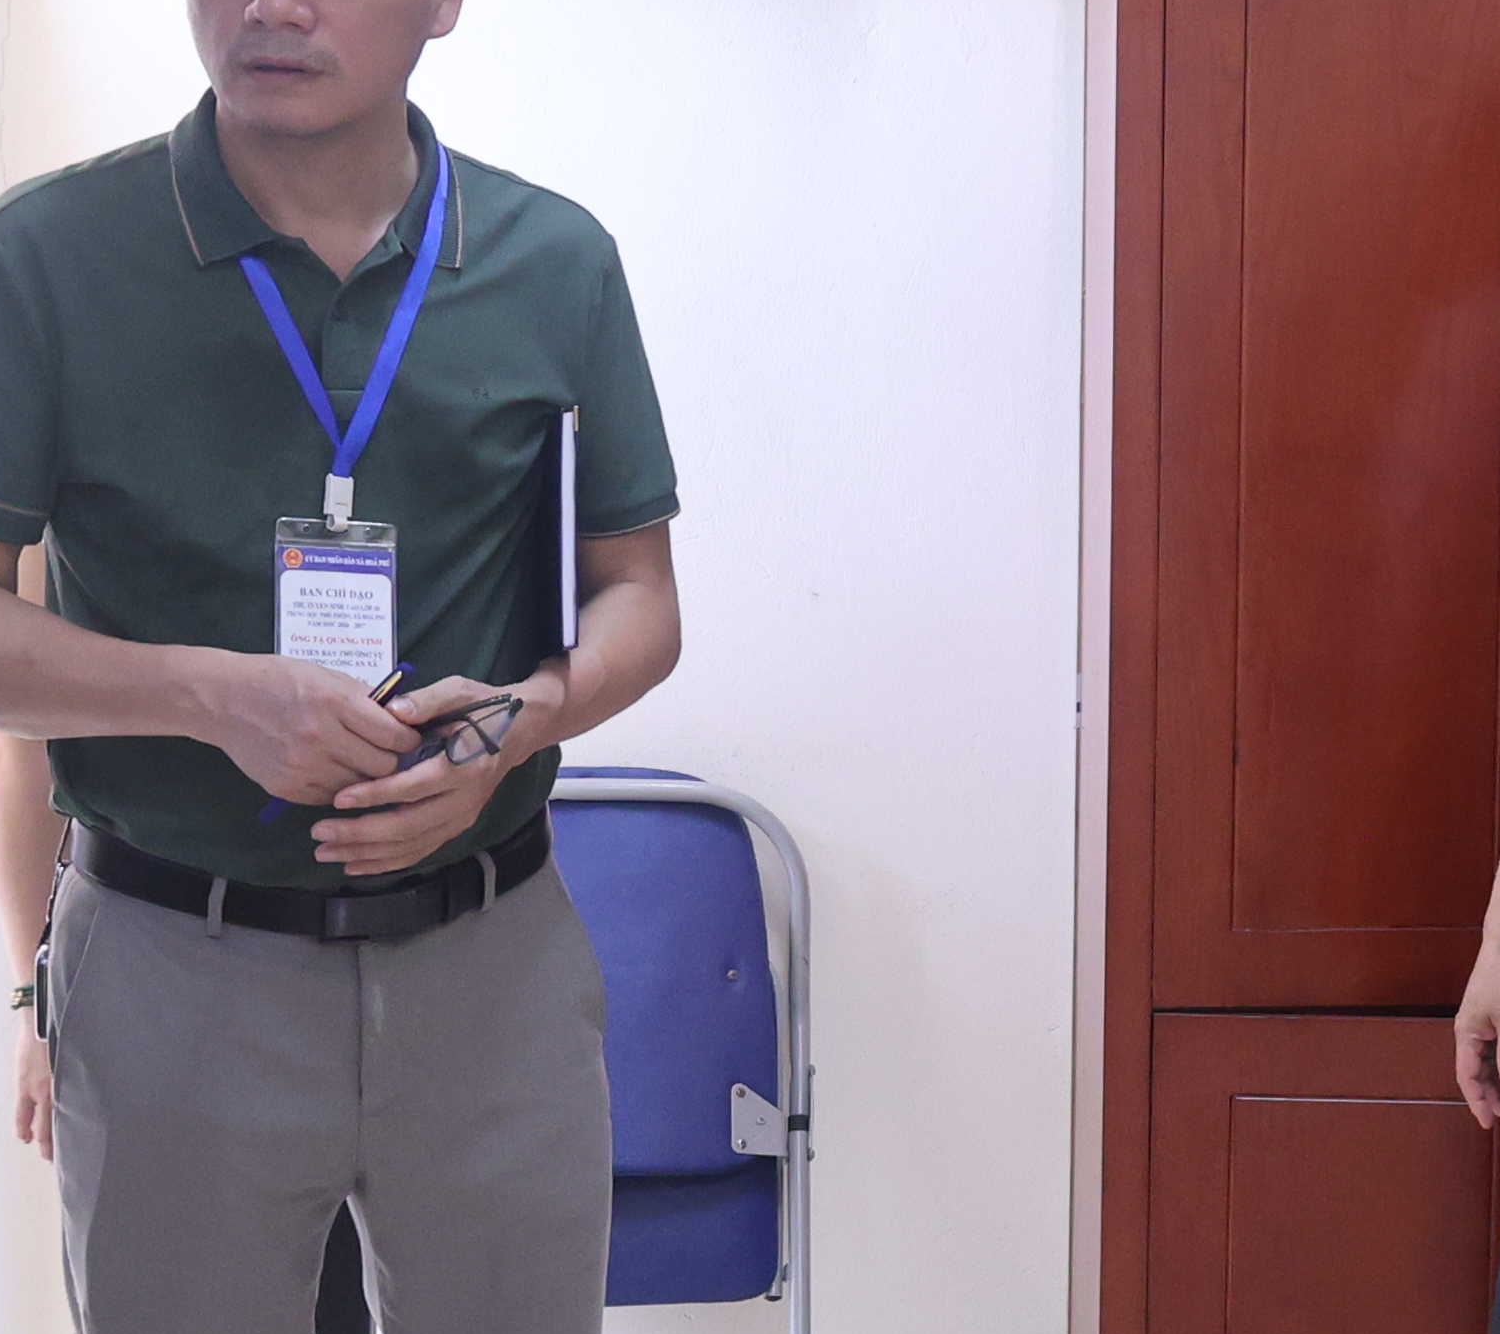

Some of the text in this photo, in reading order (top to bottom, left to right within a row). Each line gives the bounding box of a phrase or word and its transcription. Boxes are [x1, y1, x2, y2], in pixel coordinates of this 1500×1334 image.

[299, 587, 374, 601] BAN CHỈ ĐẠO
[326, 636, 359, 645] QUANG
[360, 638, 383, 646] VINH
